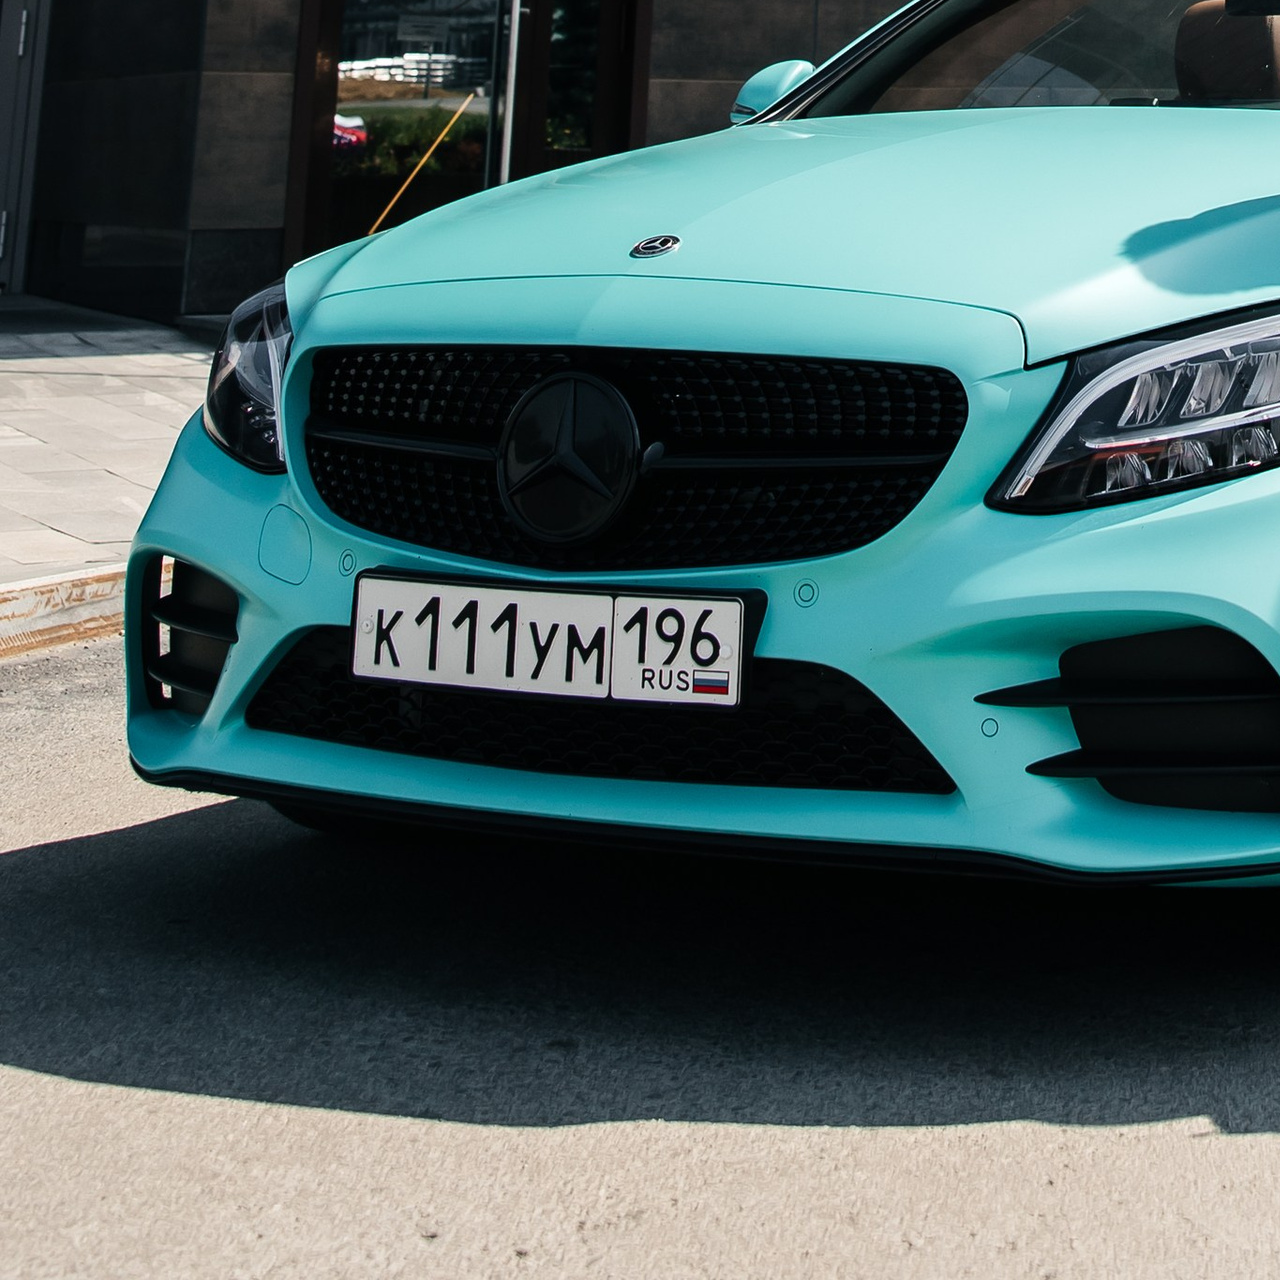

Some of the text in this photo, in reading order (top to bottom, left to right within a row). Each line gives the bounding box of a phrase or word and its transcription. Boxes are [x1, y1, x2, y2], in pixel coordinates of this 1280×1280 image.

[373, 595, 722, 686] К111УМ 196
[640, 667, 691, 692] RUS
